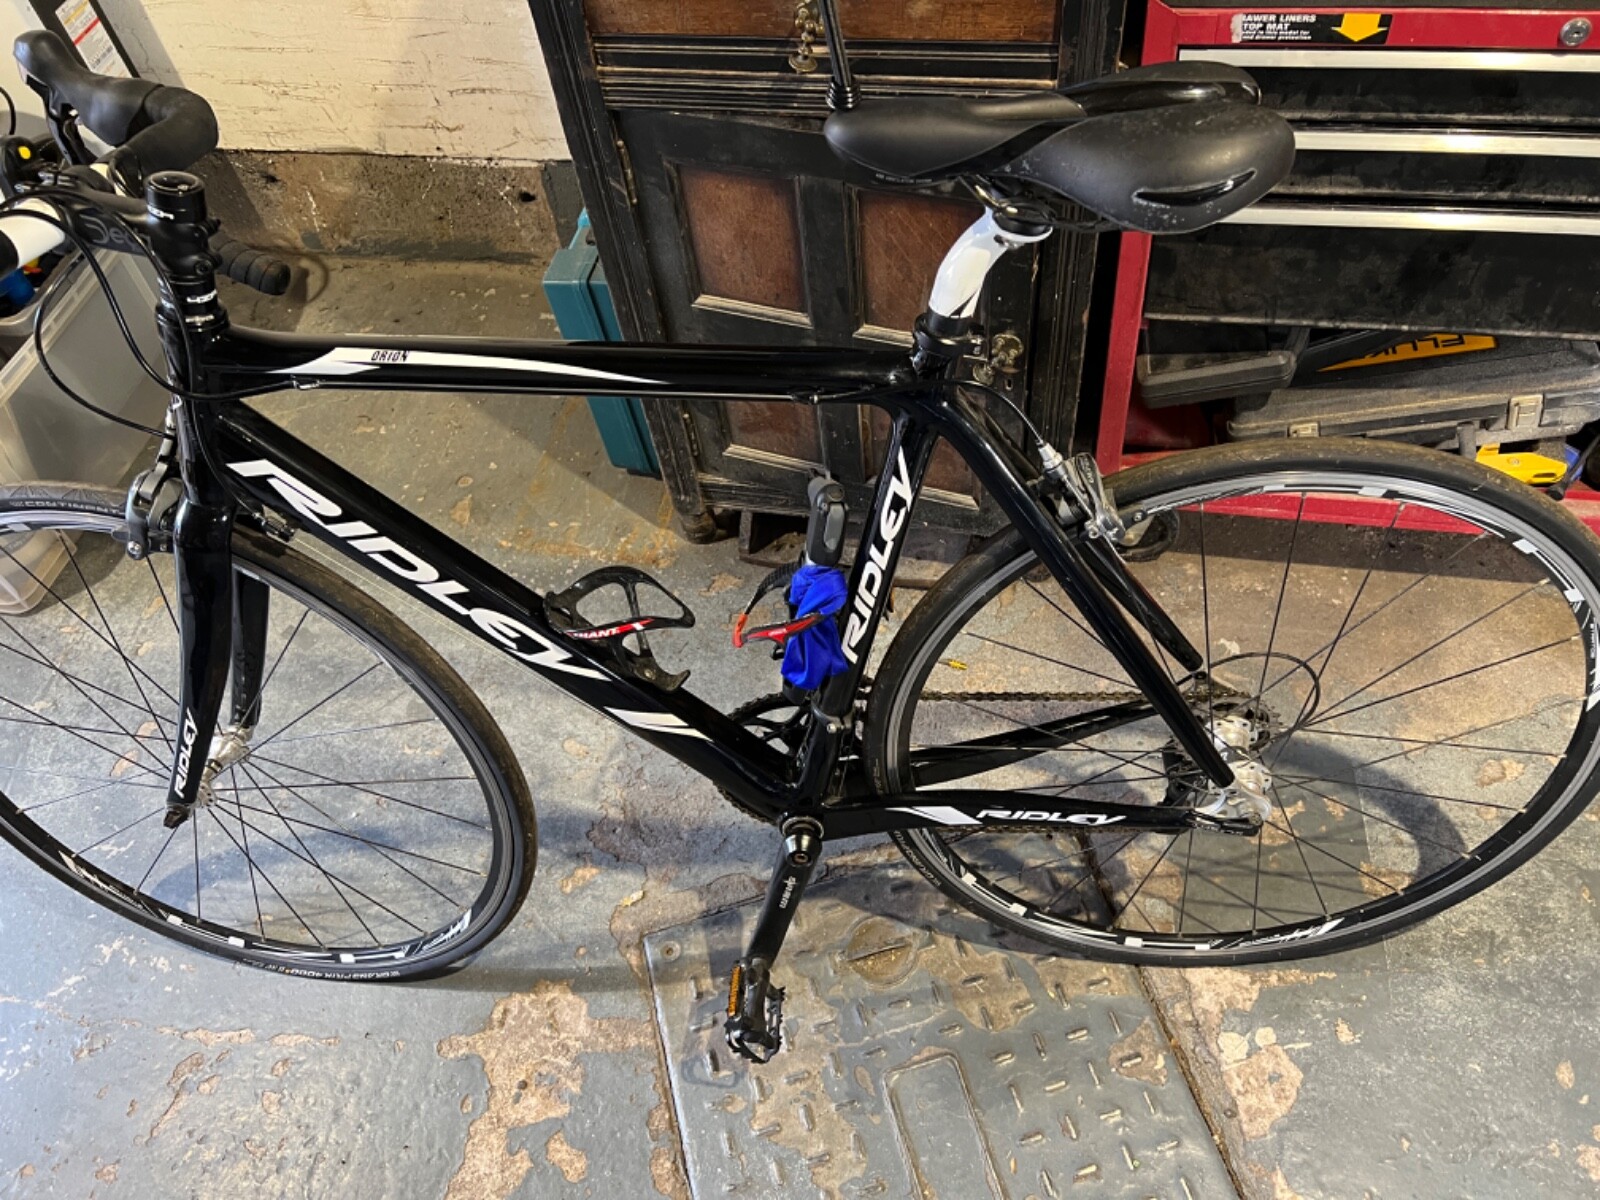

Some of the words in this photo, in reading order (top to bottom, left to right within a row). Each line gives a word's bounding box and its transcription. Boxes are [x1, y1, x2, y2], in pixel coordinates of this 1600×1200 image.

[1243, 23, 1263, 31] TOP
[1266, 23, 1291, 31] MAT
[1279, 14, 1317, 22] LINERS
[371, 350, 410, 362] ORION
[841, 445, 913, 664] RIDLEY
[226, 459, 612, 682] RIDLEY
[174, 706, 199, 800] RIDLEY
[976, 809, 1087, 827] RIDLEY
